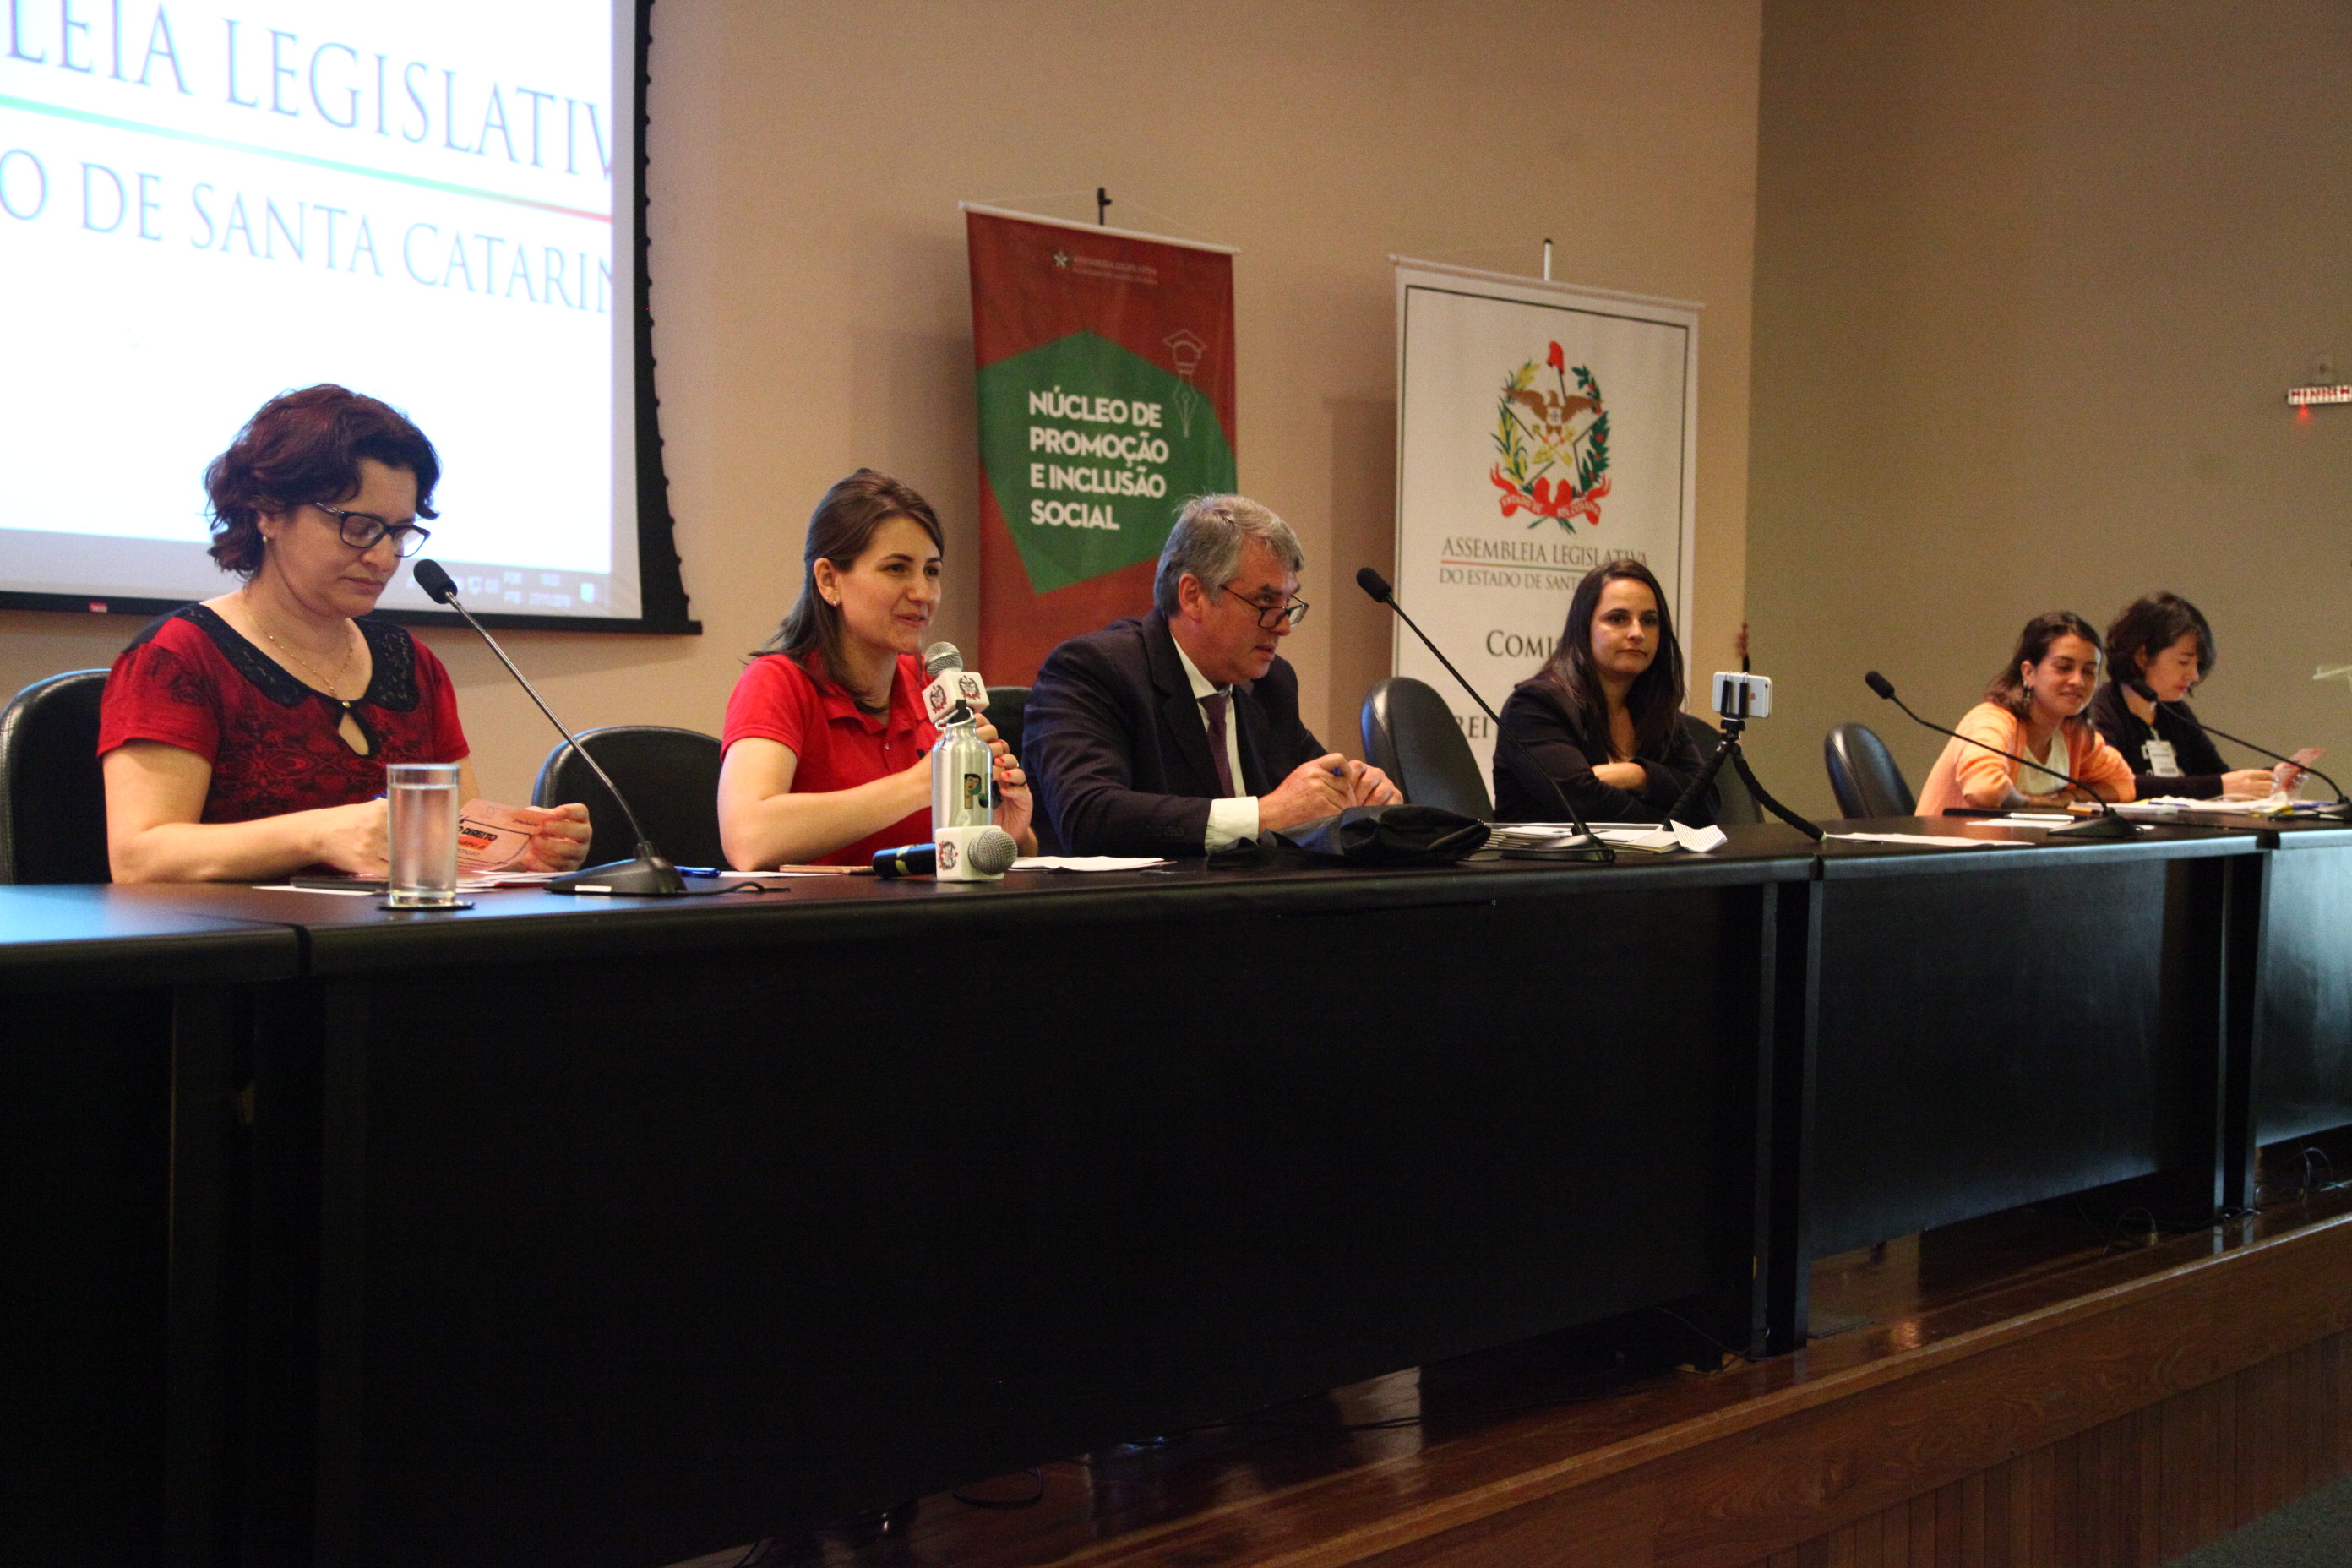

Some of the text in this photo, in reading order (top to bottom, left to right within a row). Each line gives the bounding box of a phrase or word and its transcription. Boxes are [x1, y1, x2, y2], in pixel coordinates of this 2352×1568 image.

[6, 0, 194, 95] LEIA
[79, 161, 163, 242] DE
[190, 182, 384, 278] SANTA
[1029, 386, 1162, 427] NÚCLEO DE
[1029, 427, 1169, 467] PROMOÇÃO
[1030, 463, 1167, 498] E INCLUSÃO
[1030, 499, 1120, 530] SOCIAL
[1441, 537, 1547, 564] ASSEMBLEIA
[1440, 569, 1464, 584] DO
[1467, 570, 1520, 588] ESTADO
[1524, 574, 1544, 589] DE
